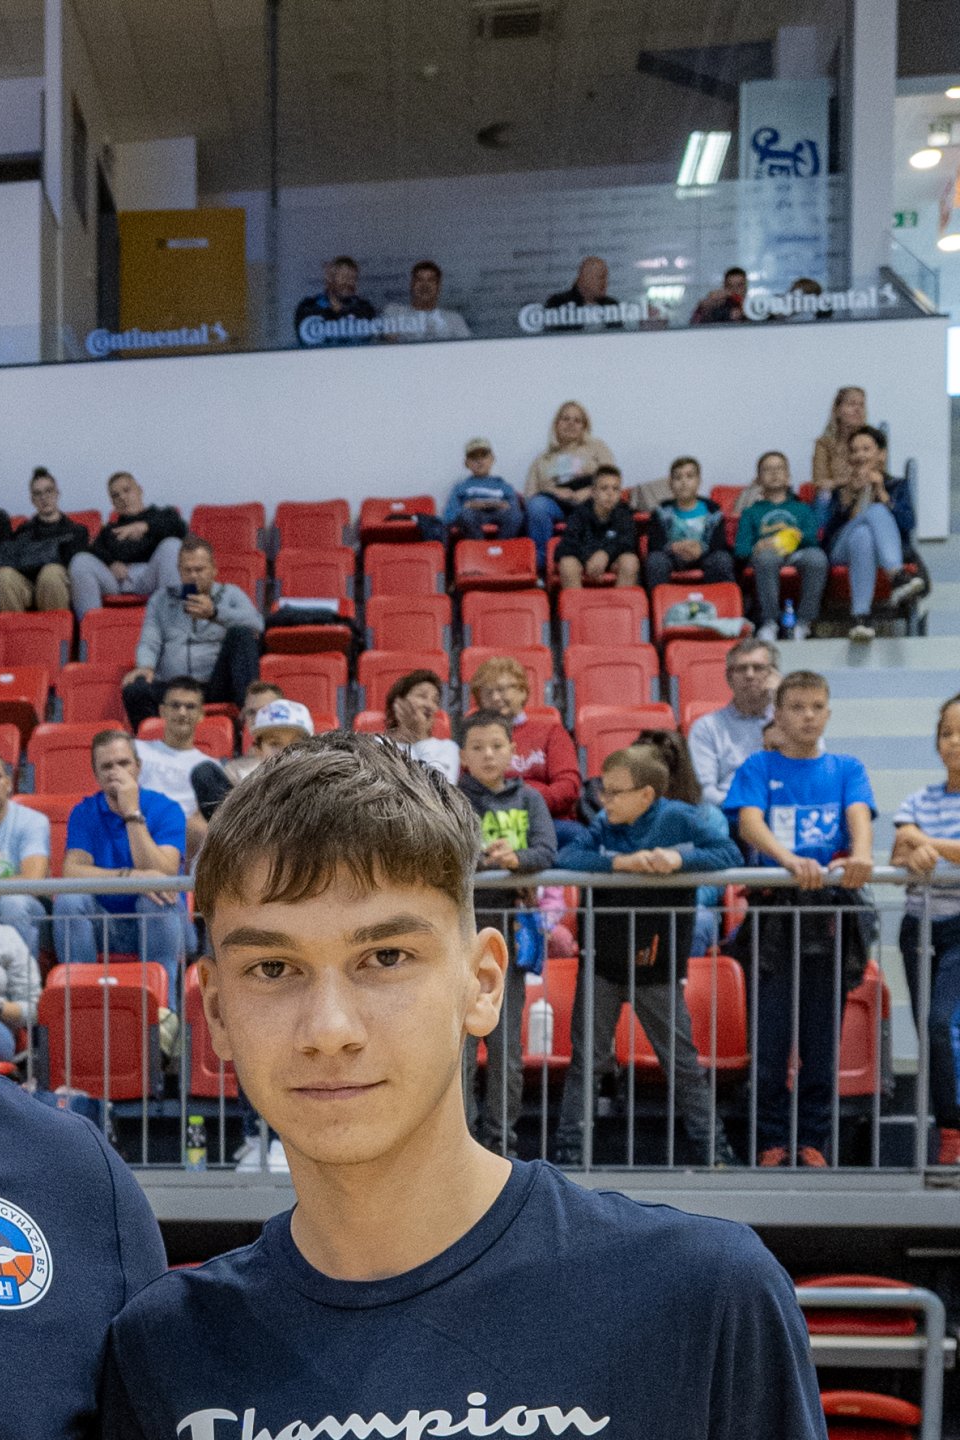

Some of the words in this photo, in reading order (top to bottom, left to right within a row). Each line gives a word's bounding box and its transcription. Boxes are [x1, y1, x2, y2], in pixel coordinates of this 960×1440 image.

[518, 300, 648, 333] Continental
[743, 285, 877, 320] Continental
[85, 323, 208, 357] Continental
[300, 313, 426, 345] Continental
[36, 1257, 45, 1275] BS
